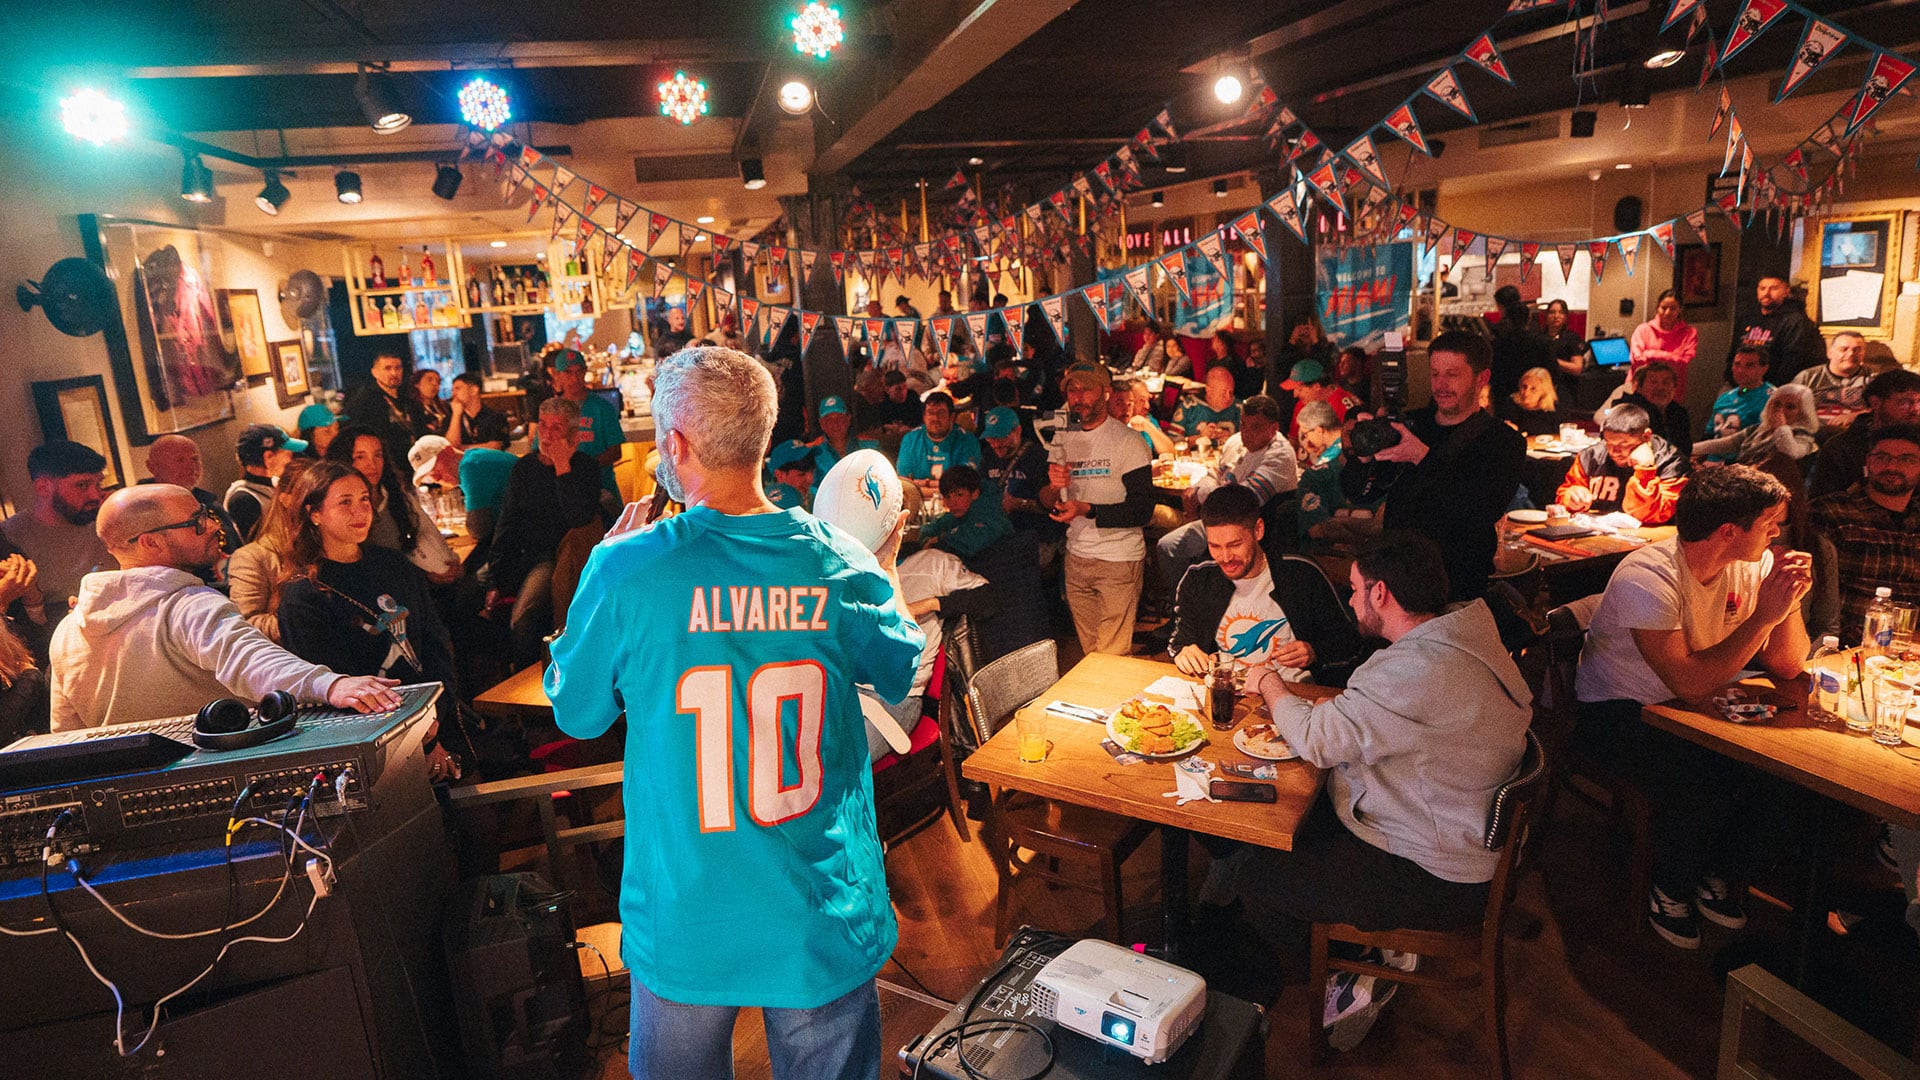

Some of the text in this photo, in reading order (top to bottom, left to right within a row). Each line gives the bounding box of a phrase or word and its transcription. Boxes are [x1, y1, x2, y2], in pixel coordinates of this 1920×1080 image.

[1163, 227, 1191, 246] ALL
[1325, 274, 1397, 318] MIAMI
[688, 586, 828, 633] ALVAREZ
[675, 658, 827, 833] 10
